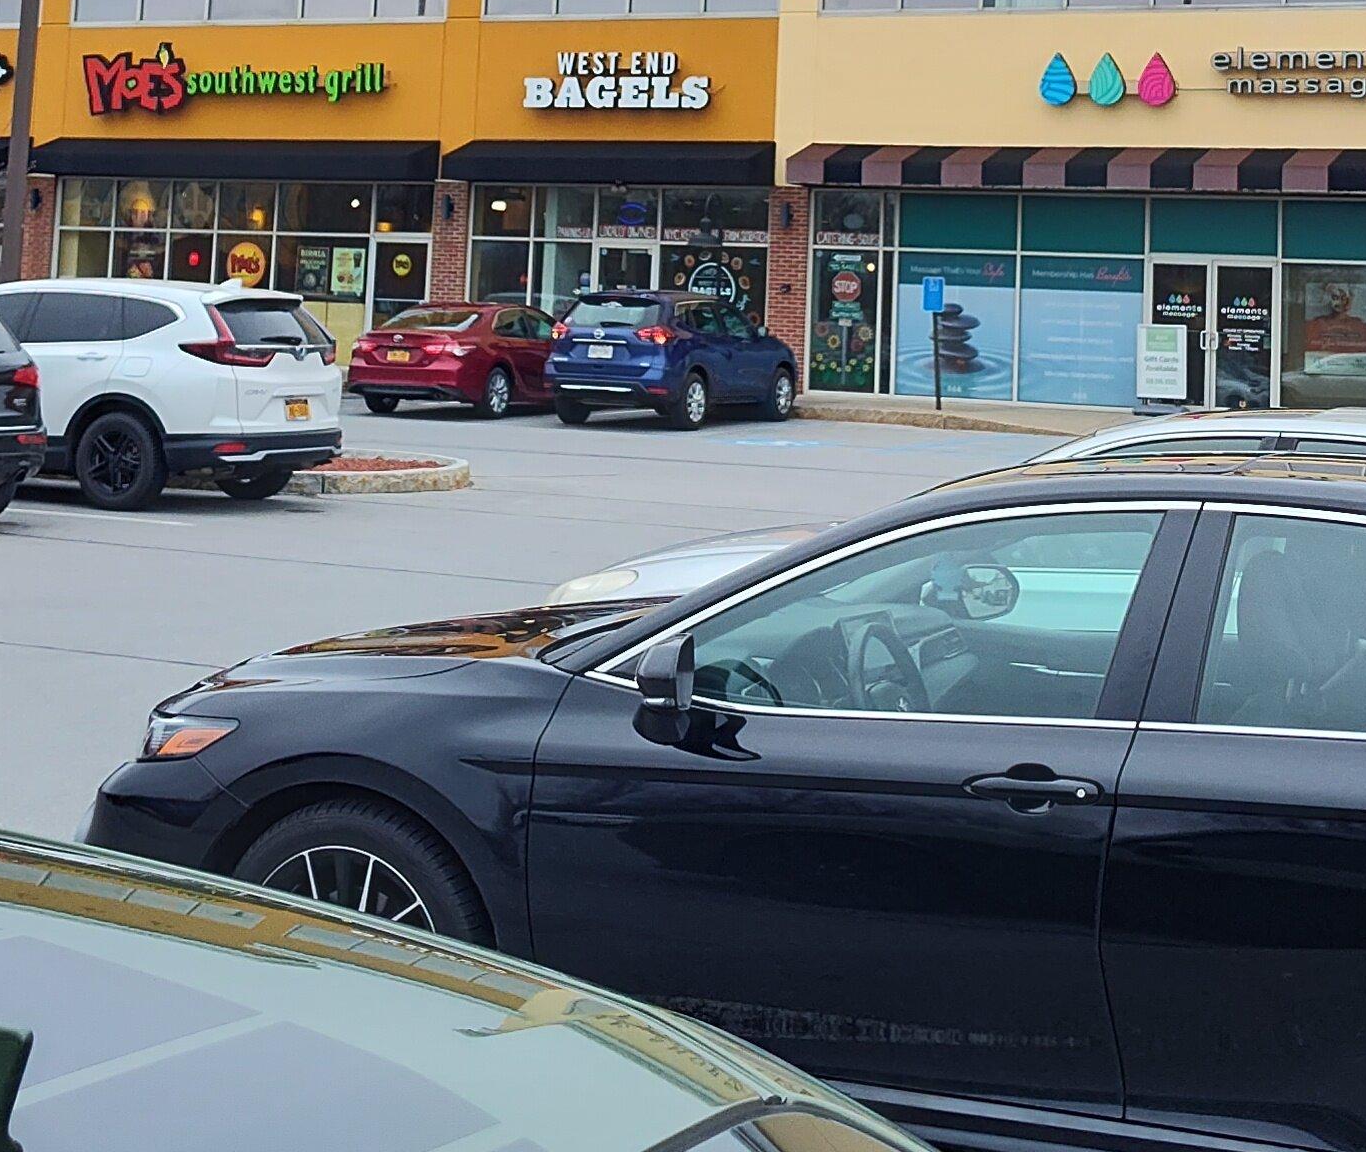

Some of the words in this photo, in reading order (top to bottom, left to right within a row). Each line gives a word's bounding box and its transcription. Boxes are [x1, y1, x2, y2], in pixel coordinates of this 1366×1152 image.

[556, 51, 618, 76] WEST
[630, 51, 679, 76] END
[186, 64, 318, 95] southwest
[324, 62, 385, 103] grill
[522, 76, 711, 110] BAGELS
[834, 280, 858, 294] STOP
